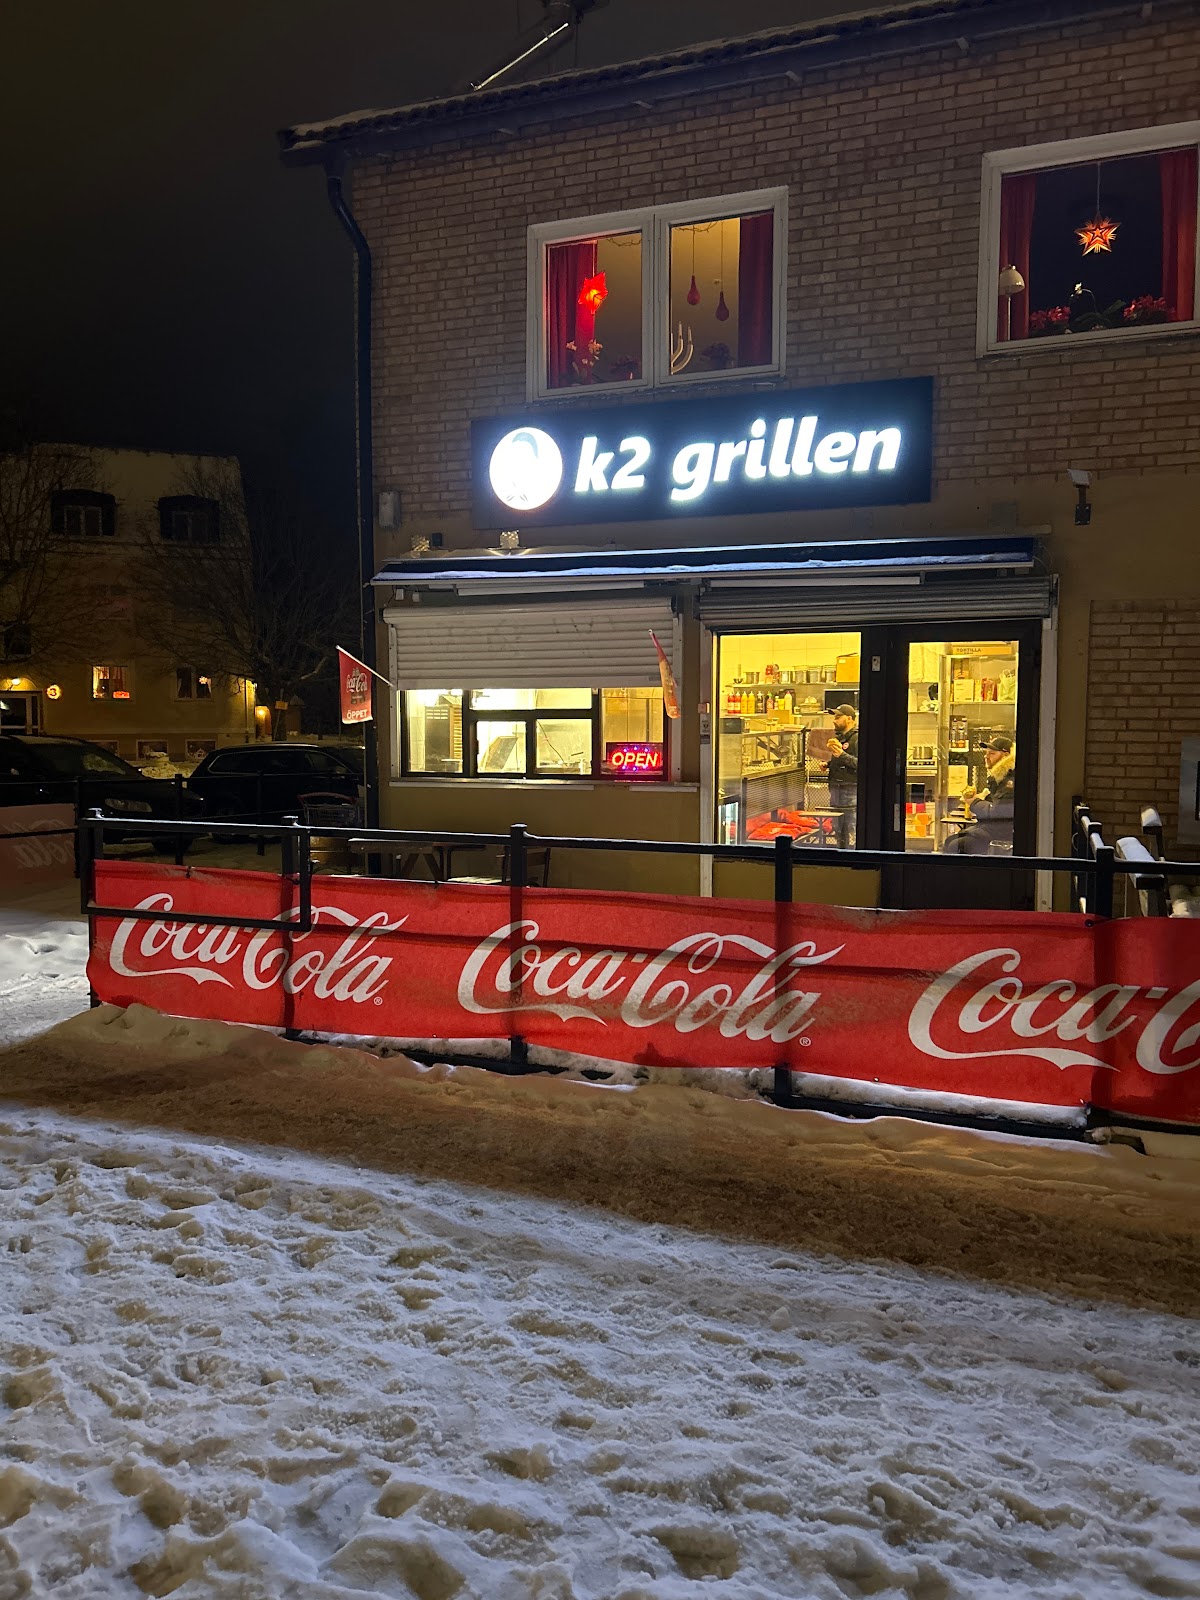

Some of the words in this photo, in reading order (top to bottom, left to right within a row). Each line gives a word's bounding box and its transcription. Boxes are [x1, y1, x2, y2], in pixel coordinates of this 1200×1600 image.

[575, 435, 651, 492] k2
[670, 415, 902, 501] grillen
[346, 708, 368, 720] ÖPPET
[611, 751, 659, 767] OPEN
[109, 892, 409, 1004] Coca-Cola
[457, 919, 846, 1044] Coca-Cola
